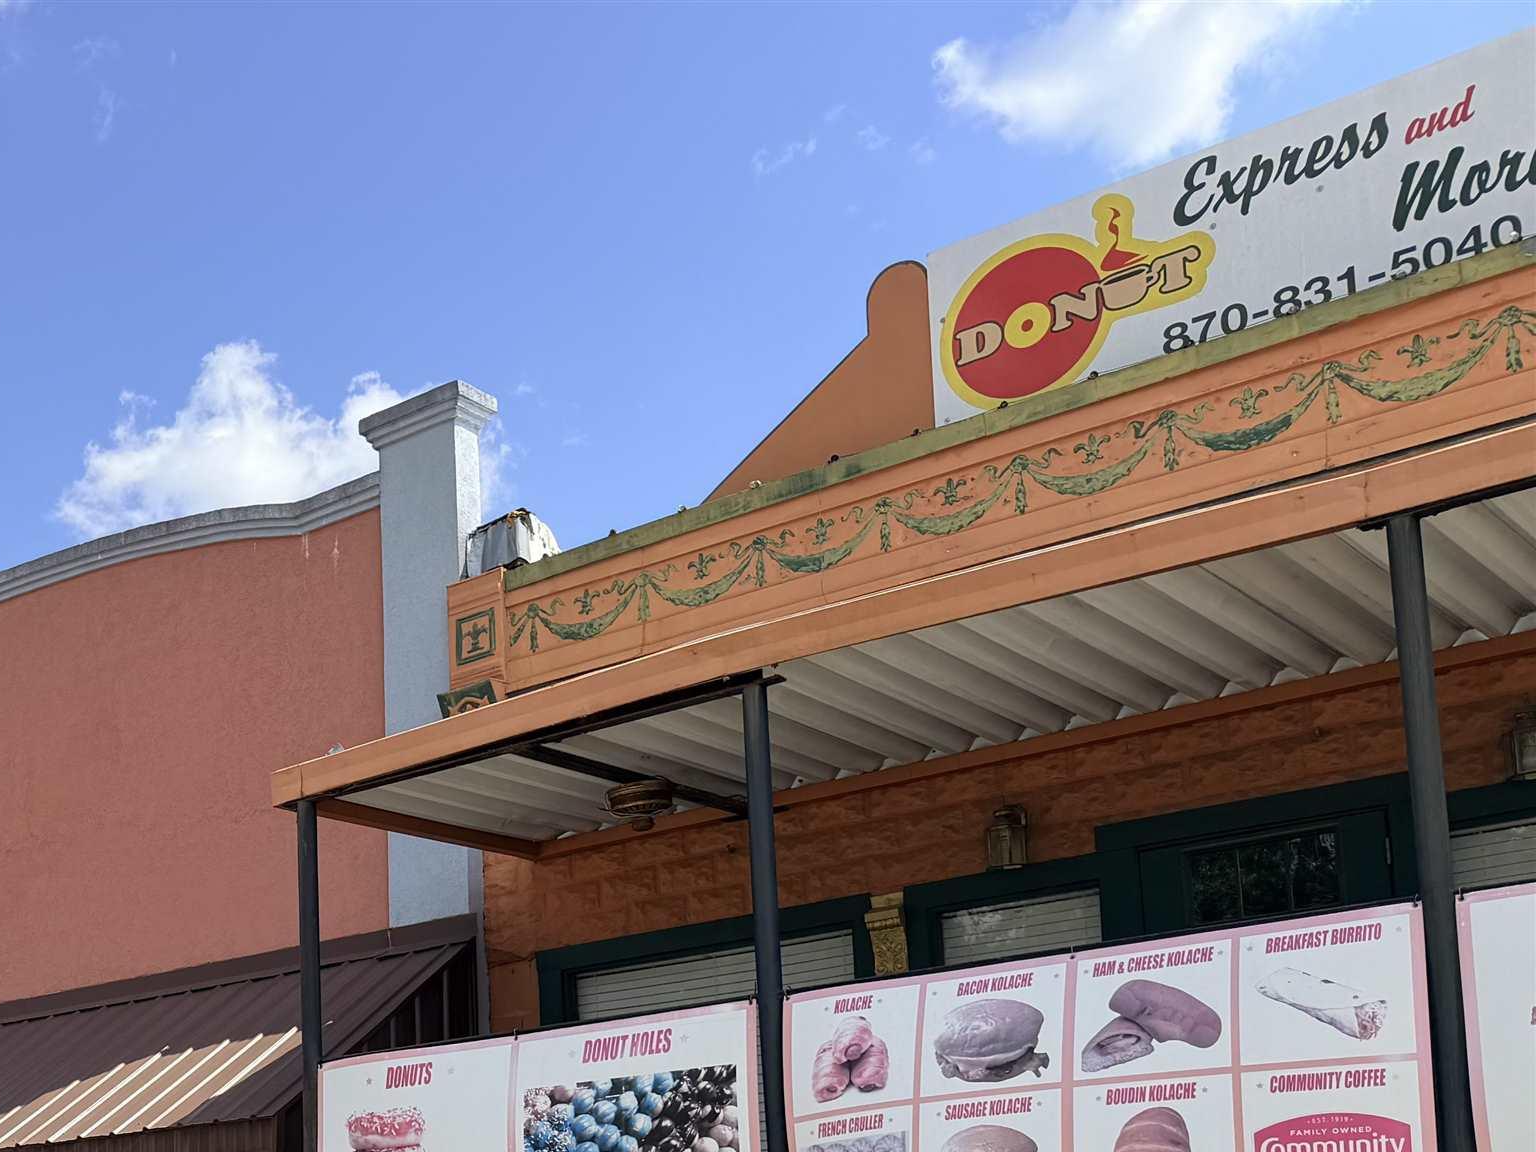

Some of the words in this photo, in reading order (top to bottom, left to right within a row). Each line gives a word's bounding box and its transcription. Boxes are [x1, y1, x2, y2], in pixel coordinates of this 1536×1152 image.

[1172, 111, 1389, 227] Express
[1404, 84, 1476, 145] and
[1391, 146, 1536, 232] Mor
[1162, 214, 1524, 355] 870-831-5040
[952, 244, 1202, 368] DONUT
[1265, 930, 1330, 954] BREAKFAST
[1331, 922, 1383, 946] BURRITO
[1092, 959, 1117, 978] HAM
[1117, 961, 1125, 974] &
[1126, 953, 1165, 973] CHEESE
[1166, 946, 1214, 968] KOLACHE
[957, 975, 990, 997] BACON
[990, 972, 1034, 993] KOLACHE
[833, 994, 874, 1015] KOLACHE
[581, 1035, 630, 1064] DONUT
[630, 1027, 672, 1058] HOLES
[385, 1062, 433, 1089] DONUTS
[1269, 1071, 1342, 1093] COMMUNITY
[1344, 1068, 1387, 1089] COFFEE
[1105, 1085, 1148, 1106] BOUDIN
[1148, 1081, 1197, 1103] KOLACHE
[944, 1099, 988, 1121] SAUSAGE
[988, 1096, 1033, 1116] KOLACHE
[817, 1117, 848, 1139] FRENCH
[848, 1113, 885, 1134] CRULLER
[1289, 1128, 1327, 1137] FAMILY
[1331, 1125, 1373, 1135] OWNED
